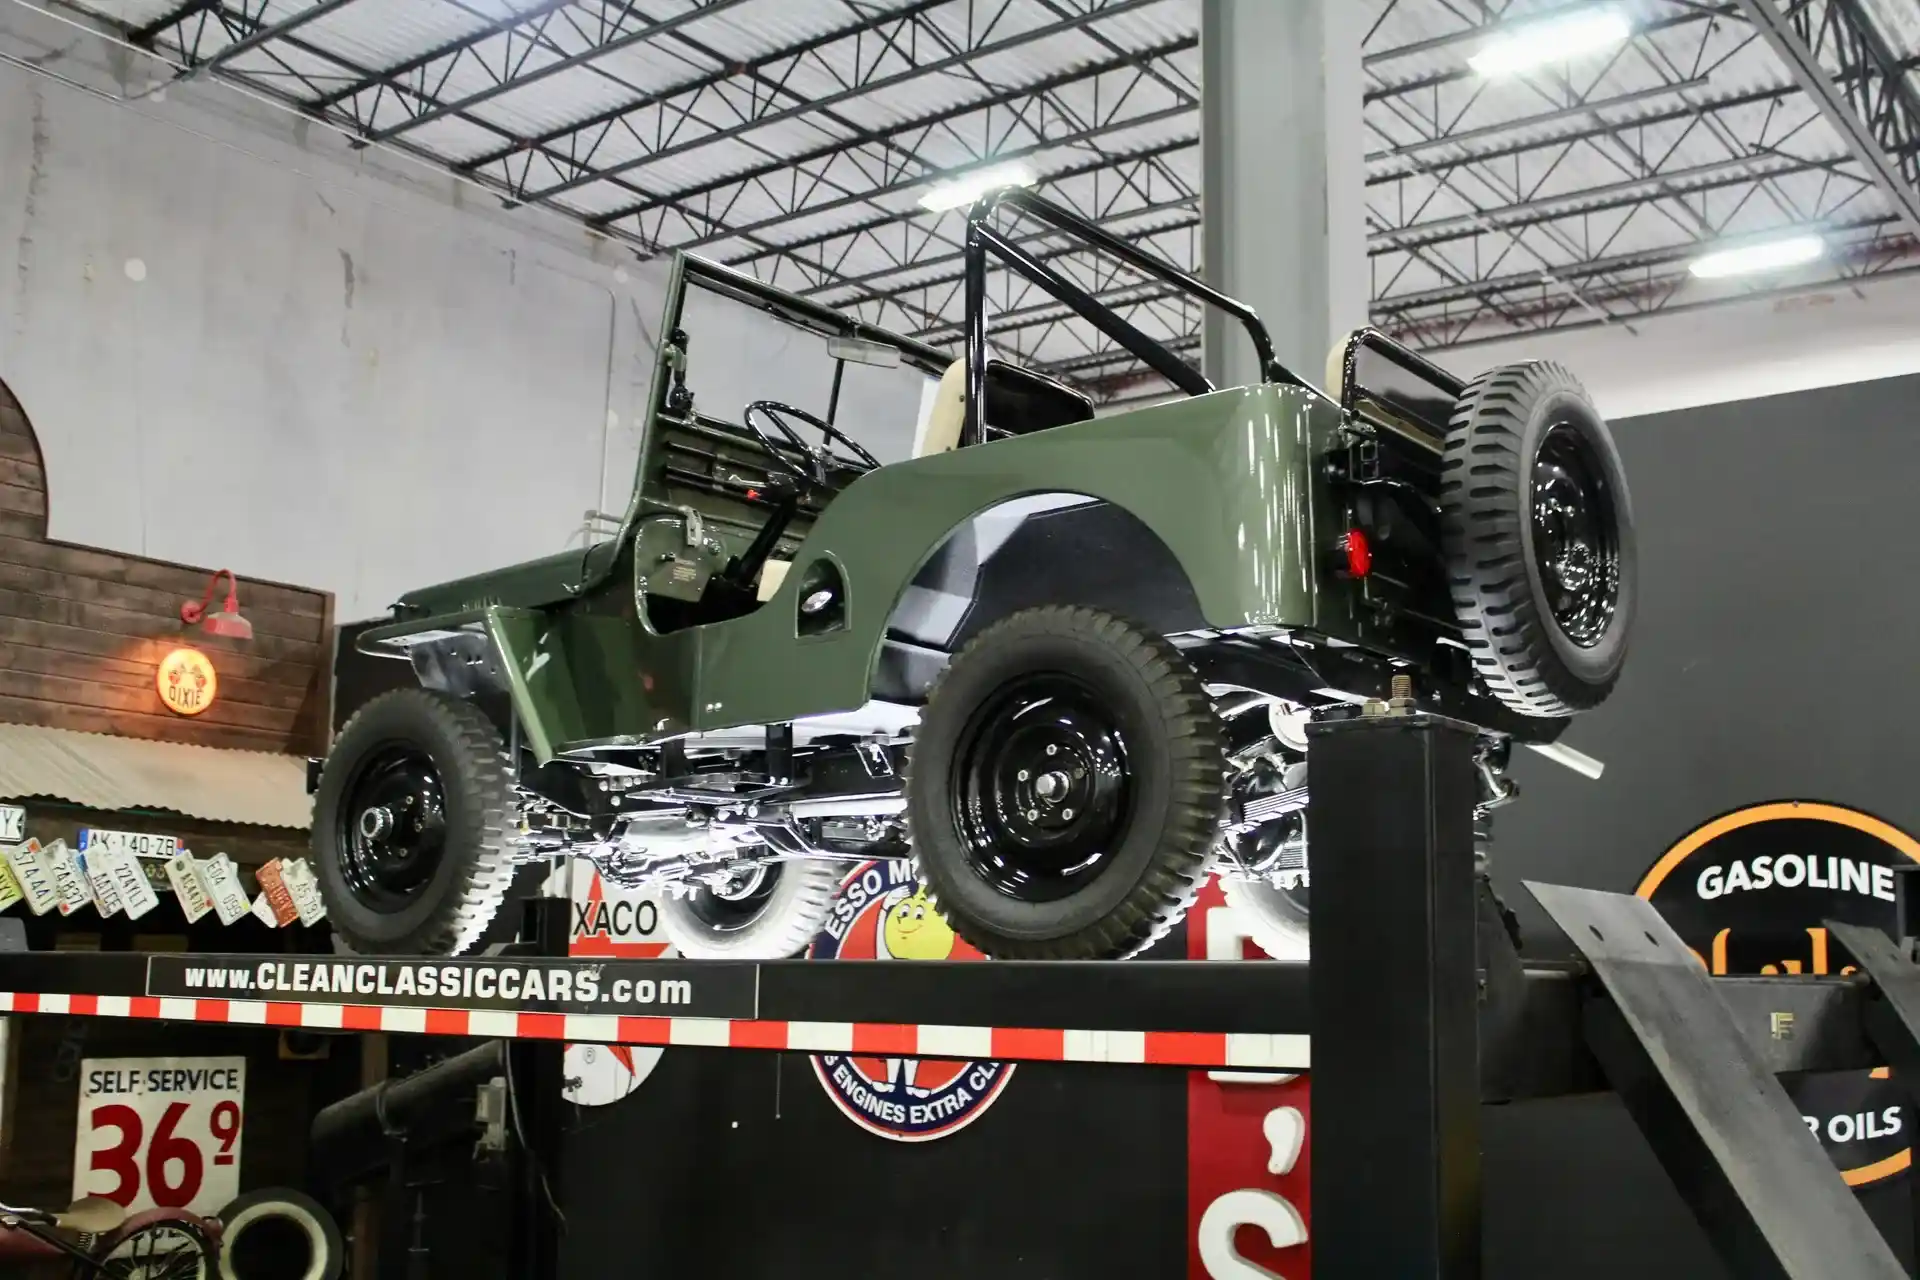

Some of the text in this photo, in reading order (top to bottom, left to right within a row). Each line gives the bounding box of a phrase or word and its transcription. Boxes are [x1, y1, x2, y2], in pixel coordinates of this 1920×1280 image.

[168, 685, 203, 708] DIXIE
[1696, 853, 1896, 902] GASOLINE
[825, 870, 883, 941] ESSO
[184, 962, 692, 1005] www.CLEANCLASSICCARS.com
[89, 1069, 239, 1094] SELF SERVICE
[832, 1065, 906, 1125] ENGINES
[909, 1089, 973, 1125] EXTRA
[968, 1061, 1000, 1091] CL
[1827, 1106, 1902, 1144] OILS
